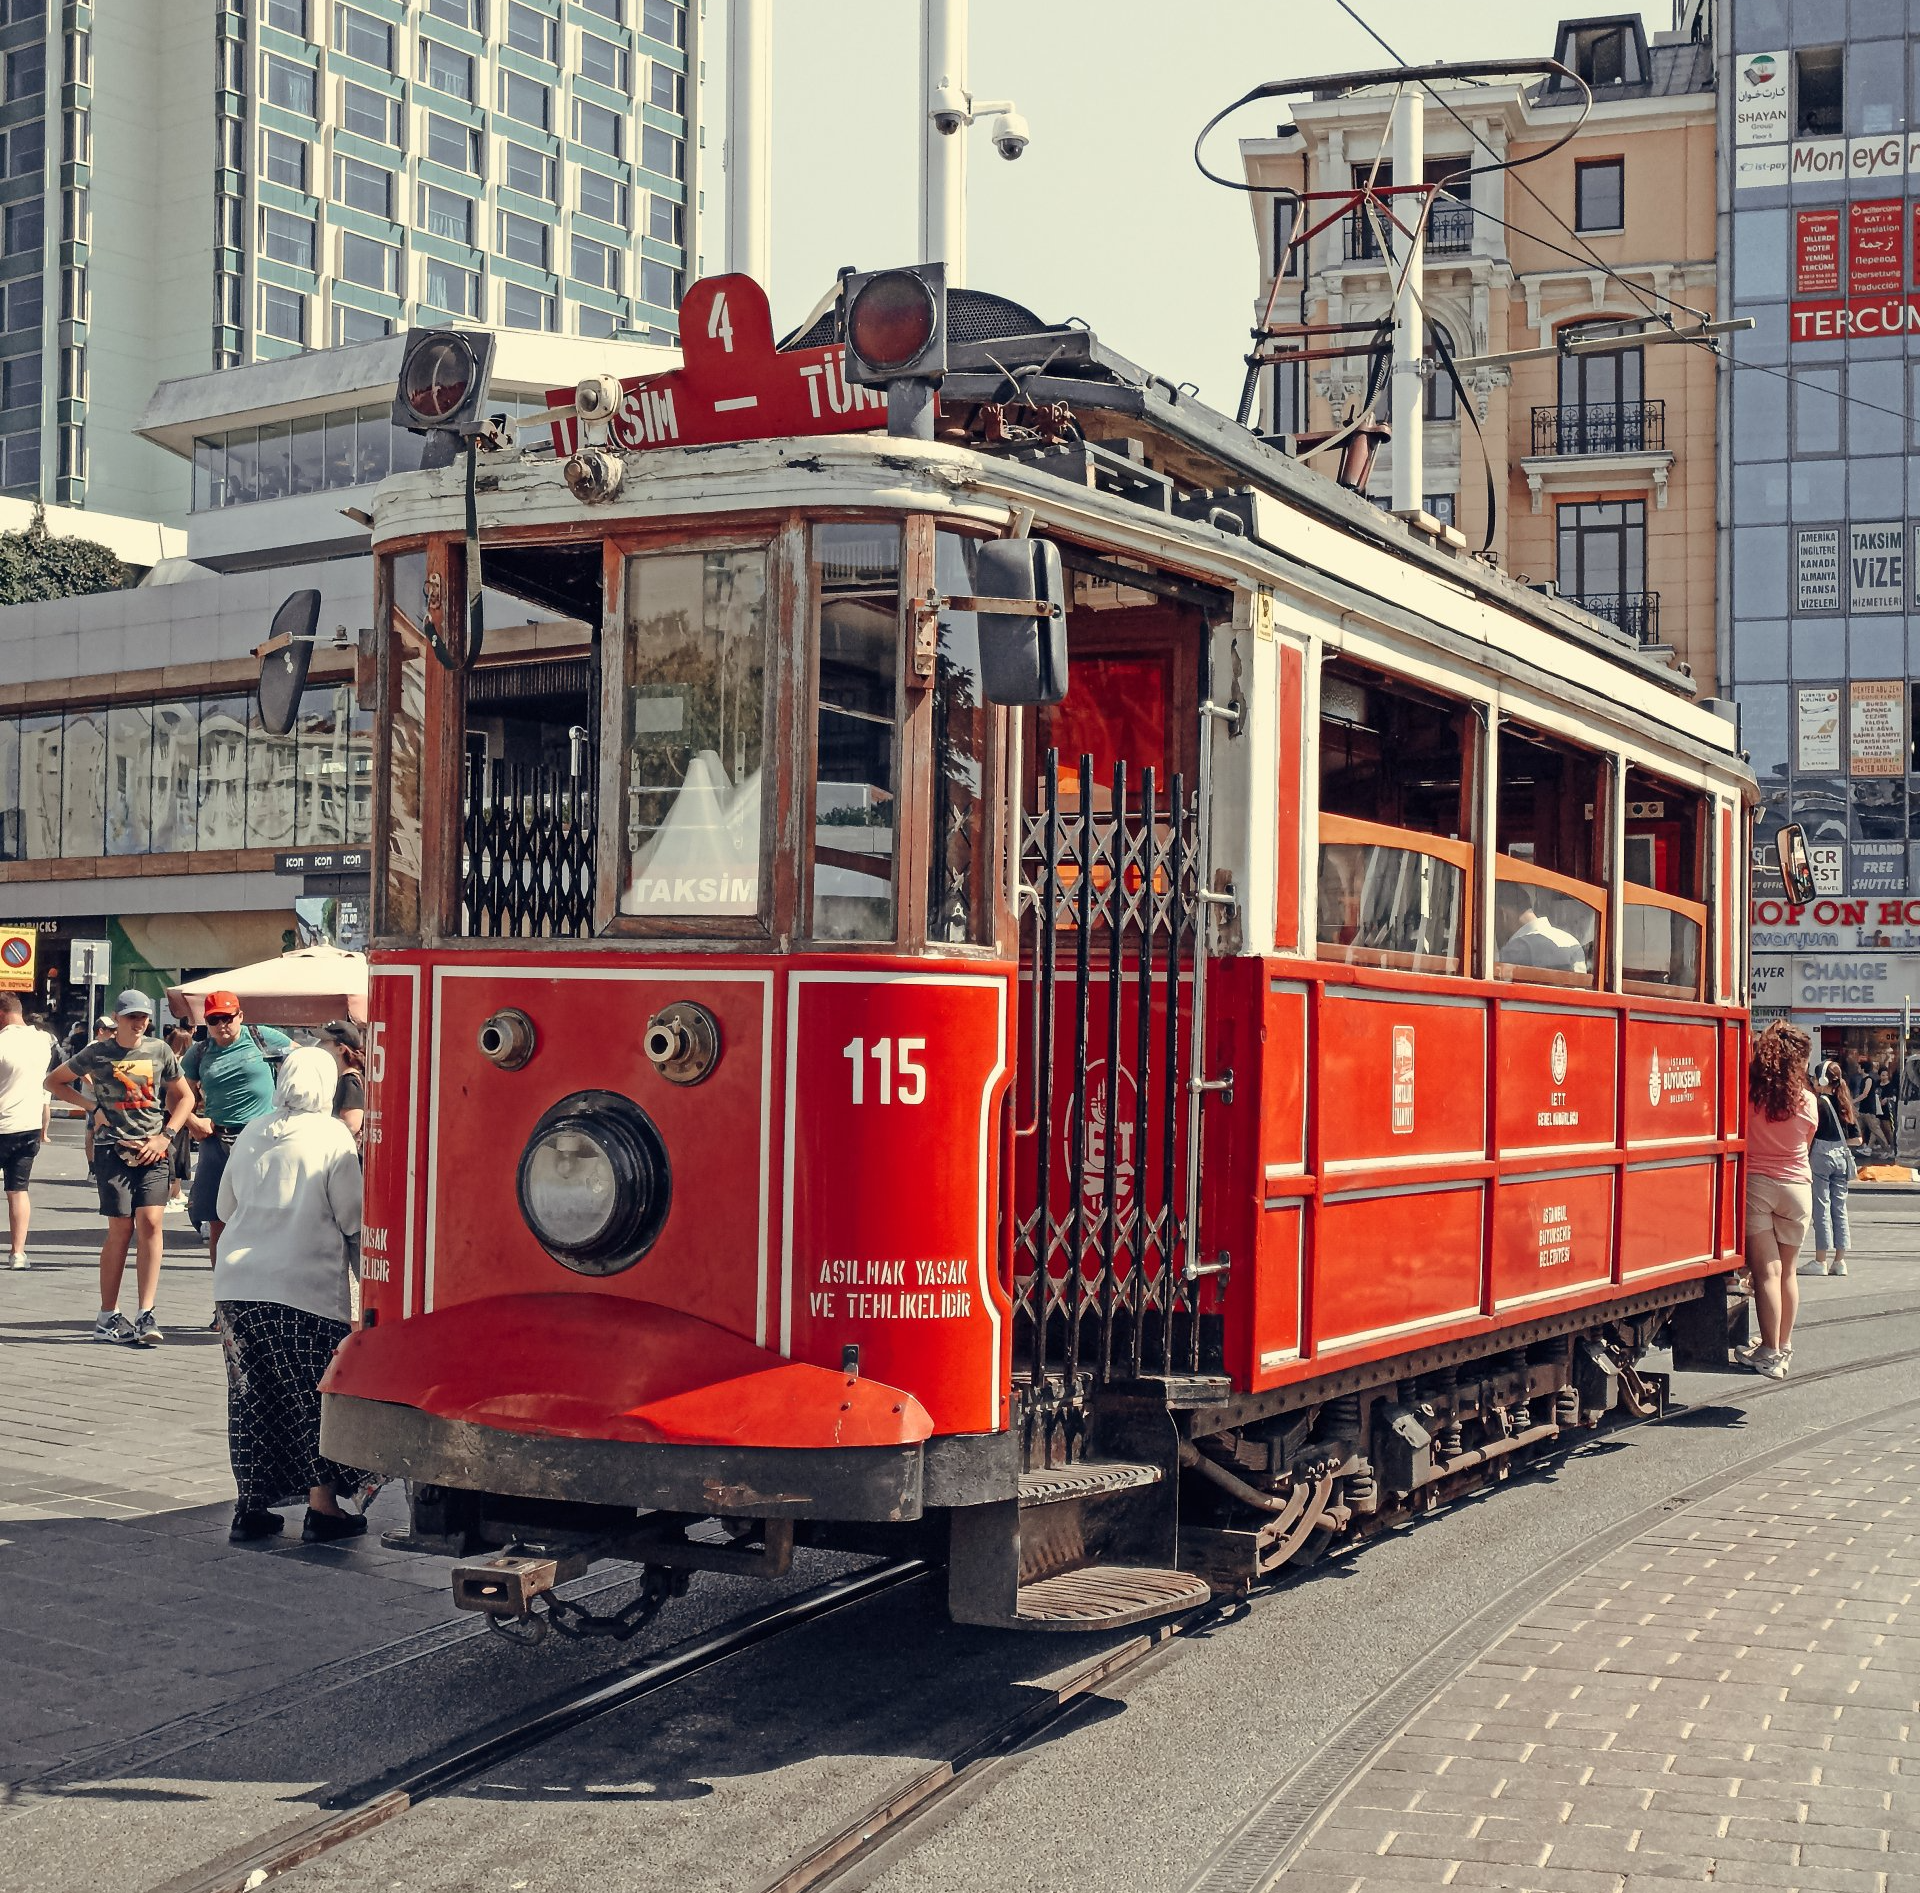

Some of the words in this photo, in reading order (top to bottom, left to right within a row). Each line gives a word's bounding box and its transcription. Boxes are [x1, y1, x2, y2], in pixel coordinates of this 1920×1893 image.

[1738, 110, 1787, 123] SHAYAN
[1854, 225, 1900, 234] Translation
[1804, 234, 1836, 242] DİLLERDE
[1860, 236, 1894, 251] ترجمة
[1856, 256, 1896, 265] Перевод
[1802, 264, 1835, 272] TERCÜME
[1851, 270, 1901, 279] Übersetzung
[1854, 282, 1900, 290] Traducción
[708, 292, 734, 352] 4
[1800, 532, 1836, 542] AMERİKA
[1852, 532, 1902, 550] TAKSİM
[1800, 546, 1836, 556] İNGİLTERE
[1800, 558, 1836, 568] KANADA
[1800, 572, 1836, 582] ALMANYA
[1852, 556, 1902, 588] VİZE
[1800, 585, 1836, 594] FRANSA
[1800, 596, 1836, 608] VİZELERİ
[1852, 596, 1902, 608] HİZMETLERİ
[1851, 844, 1905, 856] VIALAND
[1810, 851, 1837, 864] CR
[1863, 862, 1894, 874] FREE
[632, 872, 758, 903] TAKSİM
[1852, 878, 1905, 890] SHUTTLE
[341, 913, 358, 924] 20.00
[1814, 900, 1869, 926] ON
[1802, 962, 1888, 981] CHANGE
[1802, 986, 1874, 1004] OFFICE
[844, 1038, 926, 1104] 115
[820, 1260, 906, 1286] ASILMAK
[916, 1260, 968, 1286] YASAK
[810, 1292, 835, 1318] VE
[846, 1290, 970, 1318] TEHLİKELİDİR
